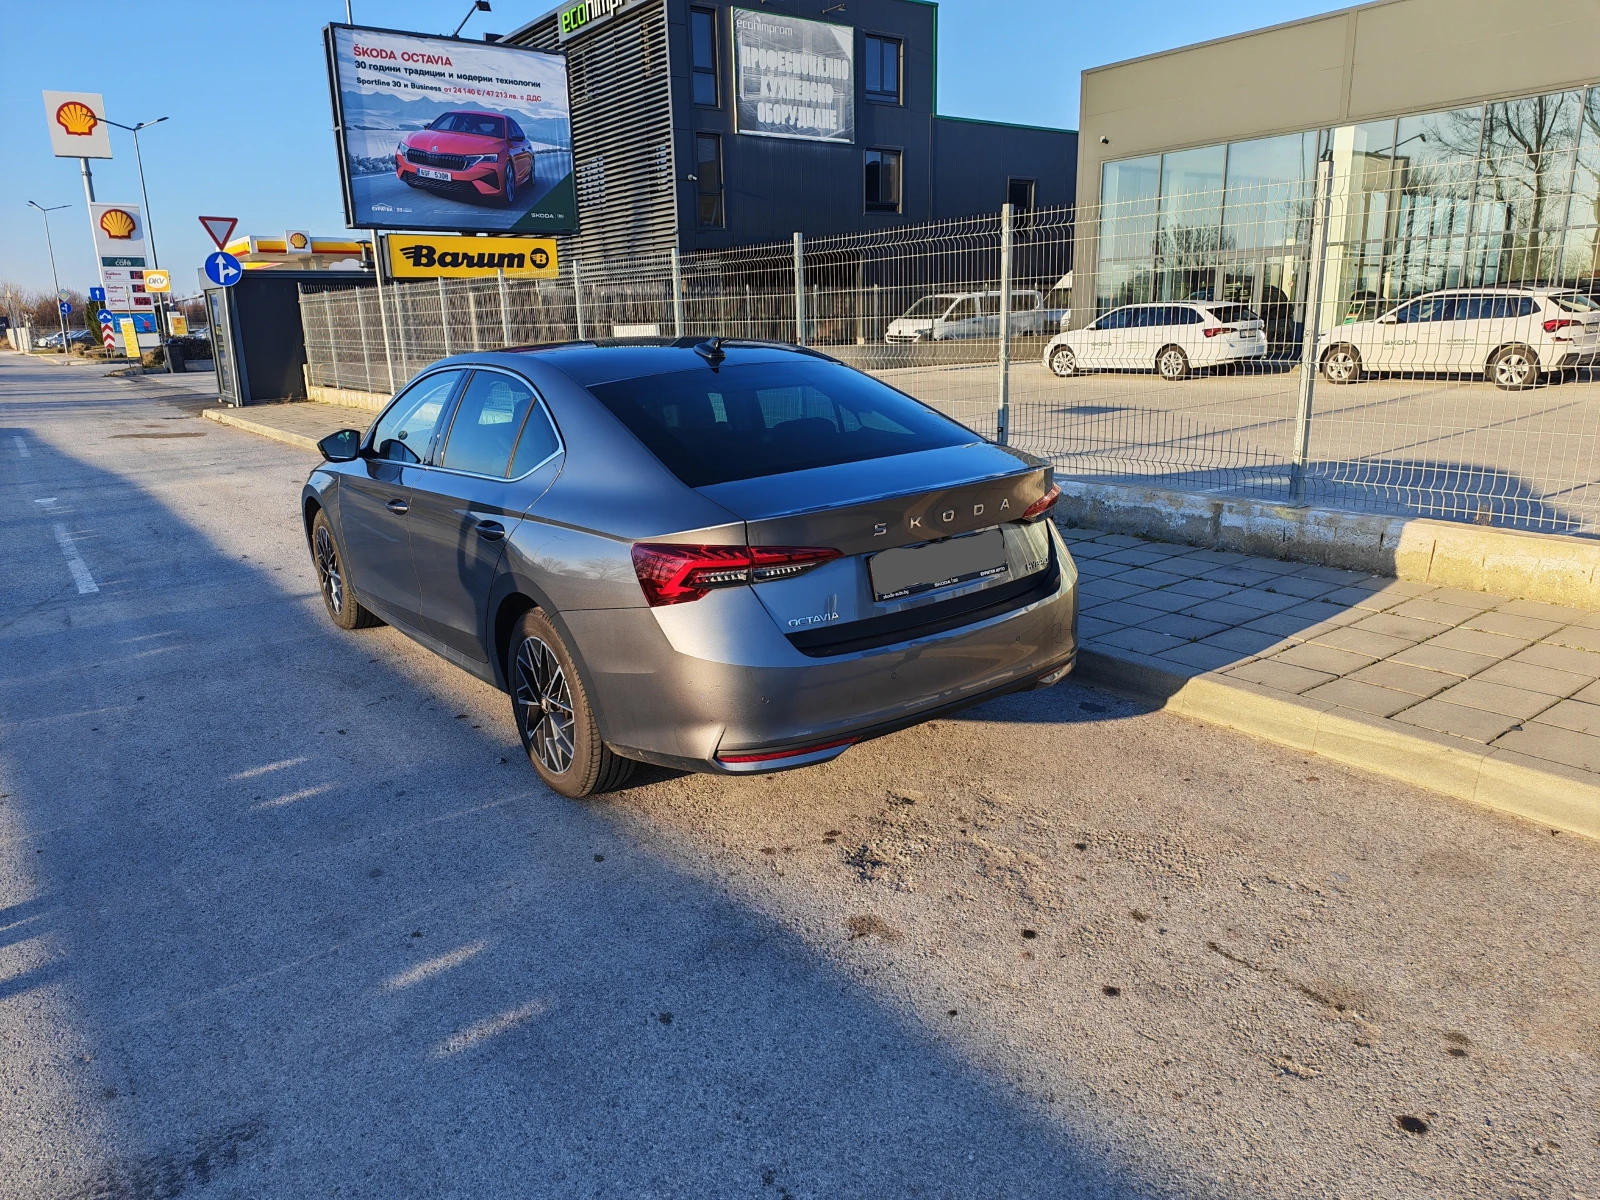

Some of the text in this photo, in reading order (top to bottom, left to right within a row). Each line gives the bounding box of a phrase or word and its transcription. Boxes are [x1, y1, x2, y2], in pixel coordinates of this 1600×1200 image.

[561, 0, 623, 33] ecohimp
[736, 17, 793, 36] ecohimprom
[353, 43, 453, 67] ŠKODA OCTAVIA
[741, 45, 849, 80] ПРОФЕСИОНАЛНО
[354, 60, 366, 69] 30
[369, 63, 401, 73] години
[404, 67, 446, 78] традиции
[456, 73, 493, 83] модерни
[495, 77, 541, 88] технологии
[356, 76, 391, 86] Sportline
[391, 80, 402, 88] 30
[410, 83, 442, 92] Business
[526, 94, 542, 103] ДДС
[760, 75, 834, 103] КУХНЕНСКО
[757, 101, 838, 130] ОБОРУДВАНЕ
[400, 244, 526, 269] Barum
[148, 277, 165, 285] DKV
[788, 611, 839, 628] OCTAVIA
